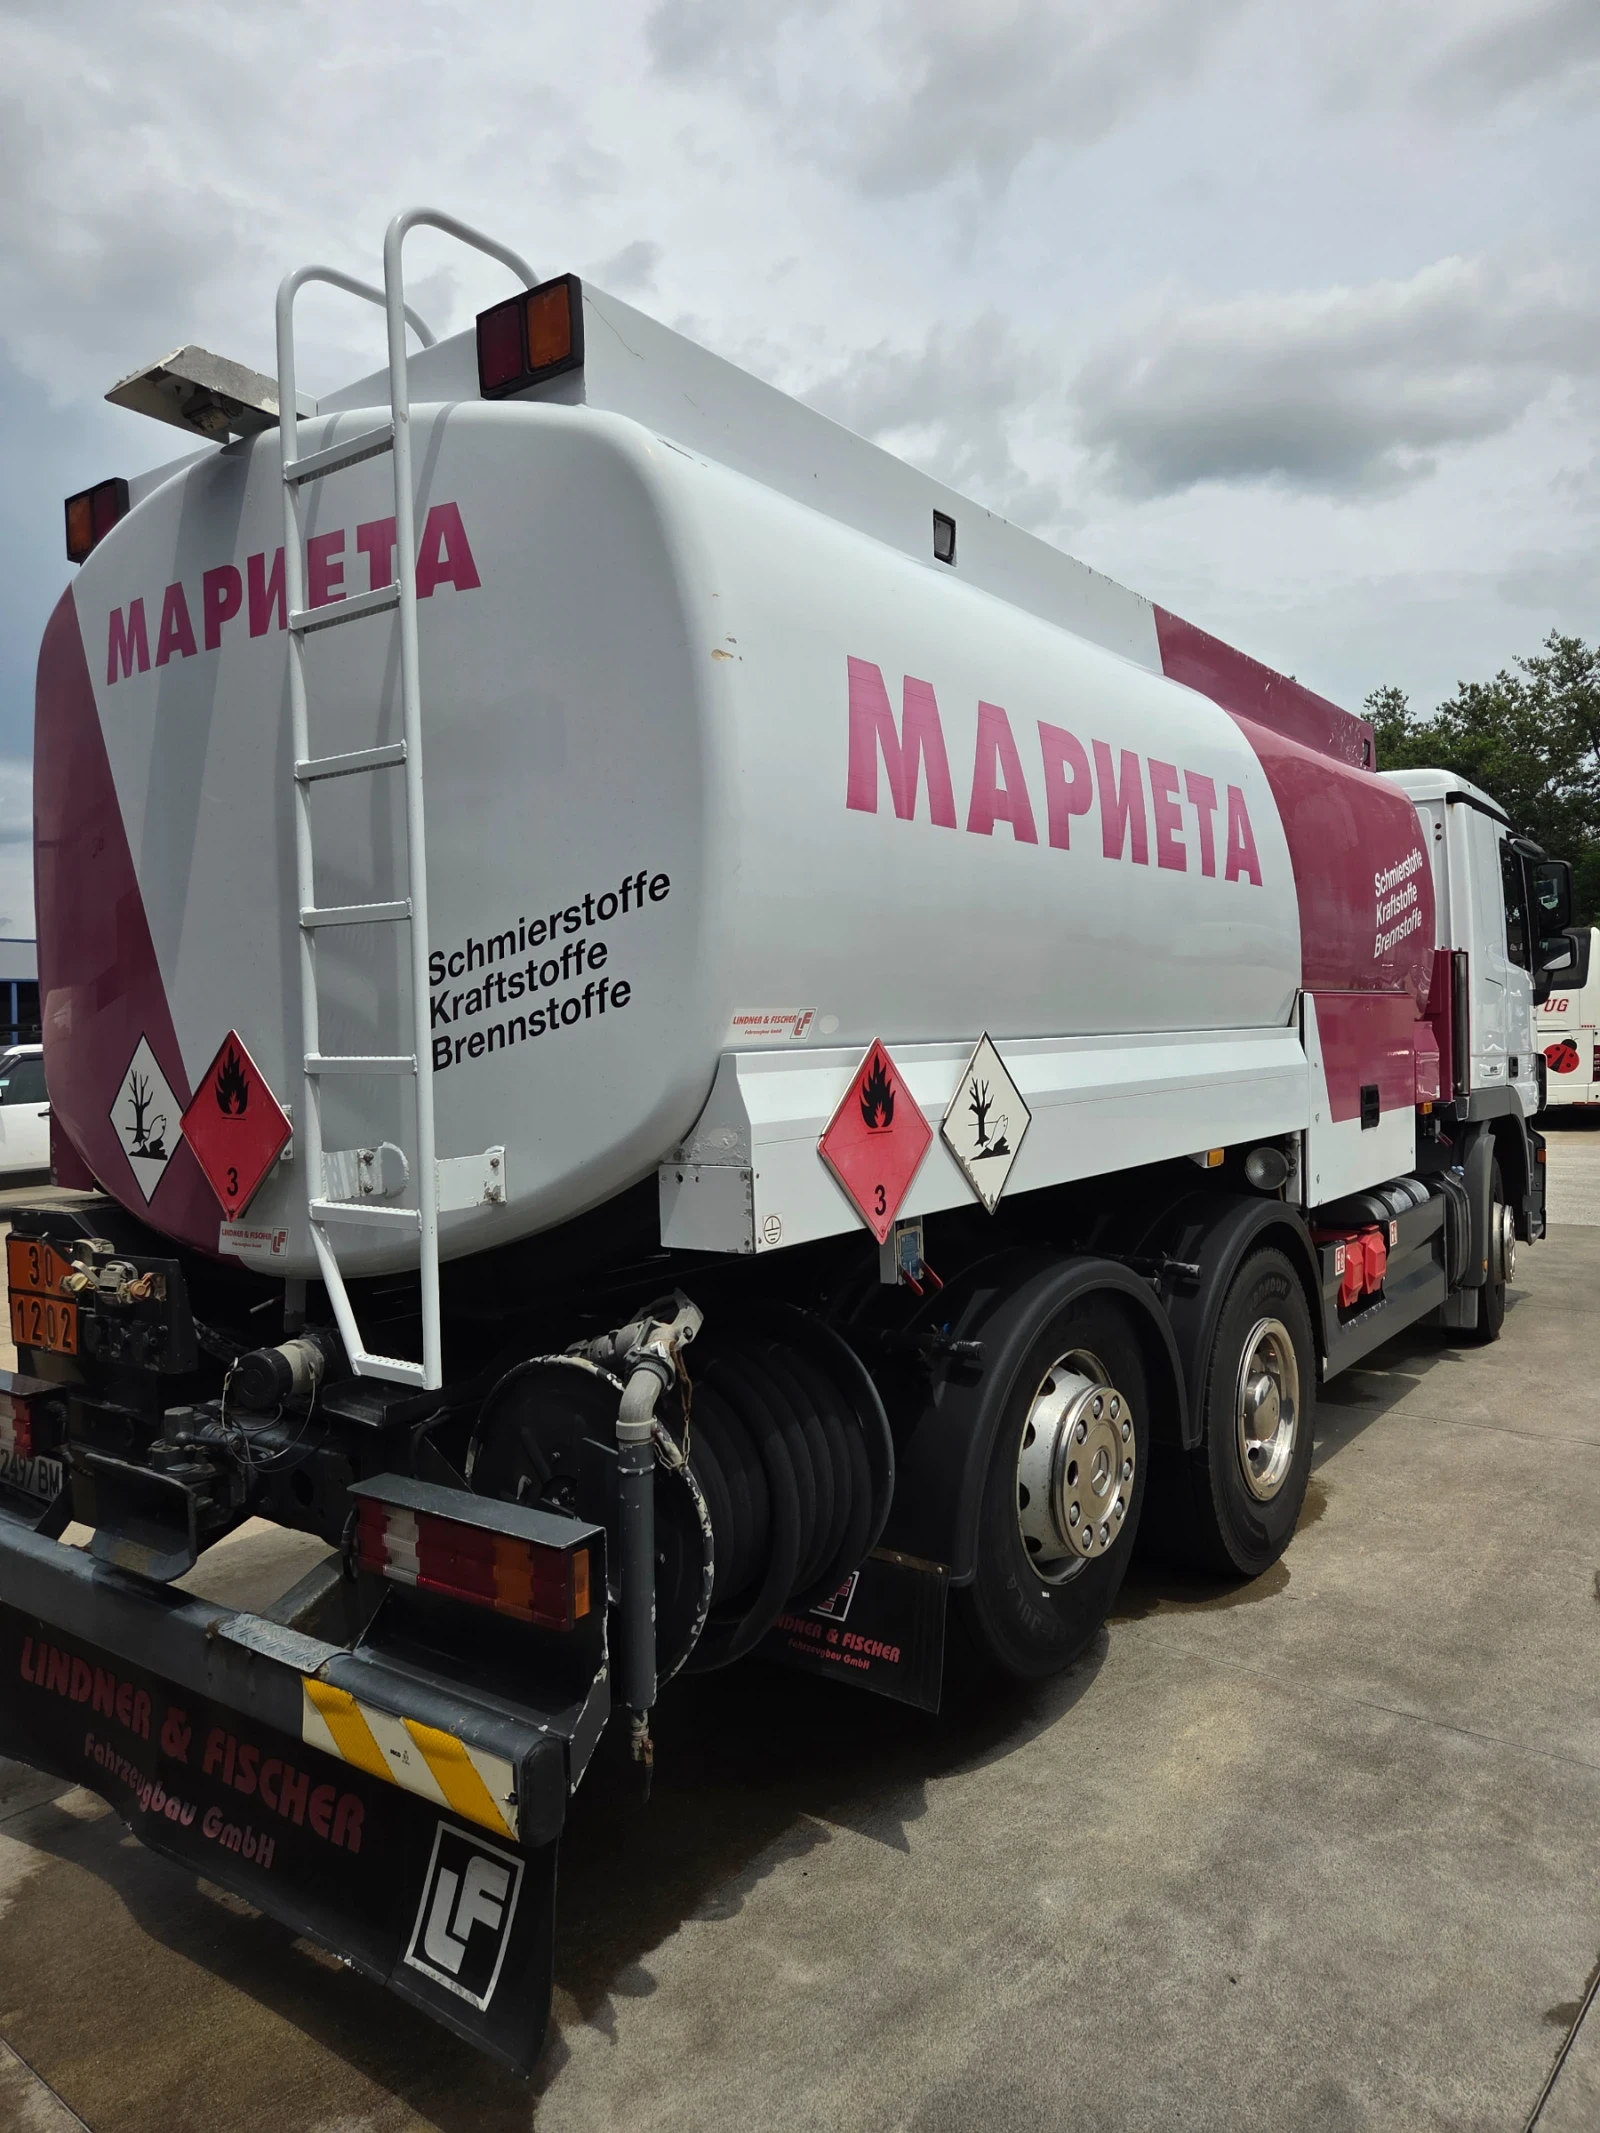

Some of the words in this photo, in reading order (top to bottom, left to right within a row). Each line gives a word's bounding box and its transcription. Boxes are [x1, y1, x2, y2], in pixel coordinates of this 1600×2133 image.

[846, 654, 1263, 887] МАРИЕТА
[1374, 847, 1423, 898] Schmierstoffe
[428, 869, 671, 987] Schmierstoffe
[1376, 881, 1418, 928] Kraftstoffe
[1373, 906, 1422, 959] Brennstoffe
[430, 938, 608, 1030] Kraftstoffe
[1544, 998, 1569, 1012] UG
[432, 976, 632, 1073] Brennstoffe
[733, 1016, 762, 1025] LINDNER
[763, 1015, 769, 1024] &
[770, 1015, 797, 1024] FISCHER
[226, 1167, 239, 1198] 3
[874, 1184, 887, 1216] 3
[29, 1245, 54, 1288] 30
[17, 1299, 73, 1349] 1202
[774, 1614, 823, 1639] NDNER
[826, 1628, 839, 1644] &
[842, 1632, 901, 1664] FISCHER
[842, 1653, 871, 1671] GmbH
[20, 1636, 153, 1741] LINDNER
[160, 1706, 192, 1764] &
[203, 1727, 366, 1855] FISCHER
[84, 1732, 198, 1827] Fahrzeugbau
[203, 1806, 276, 1869] GmbH
